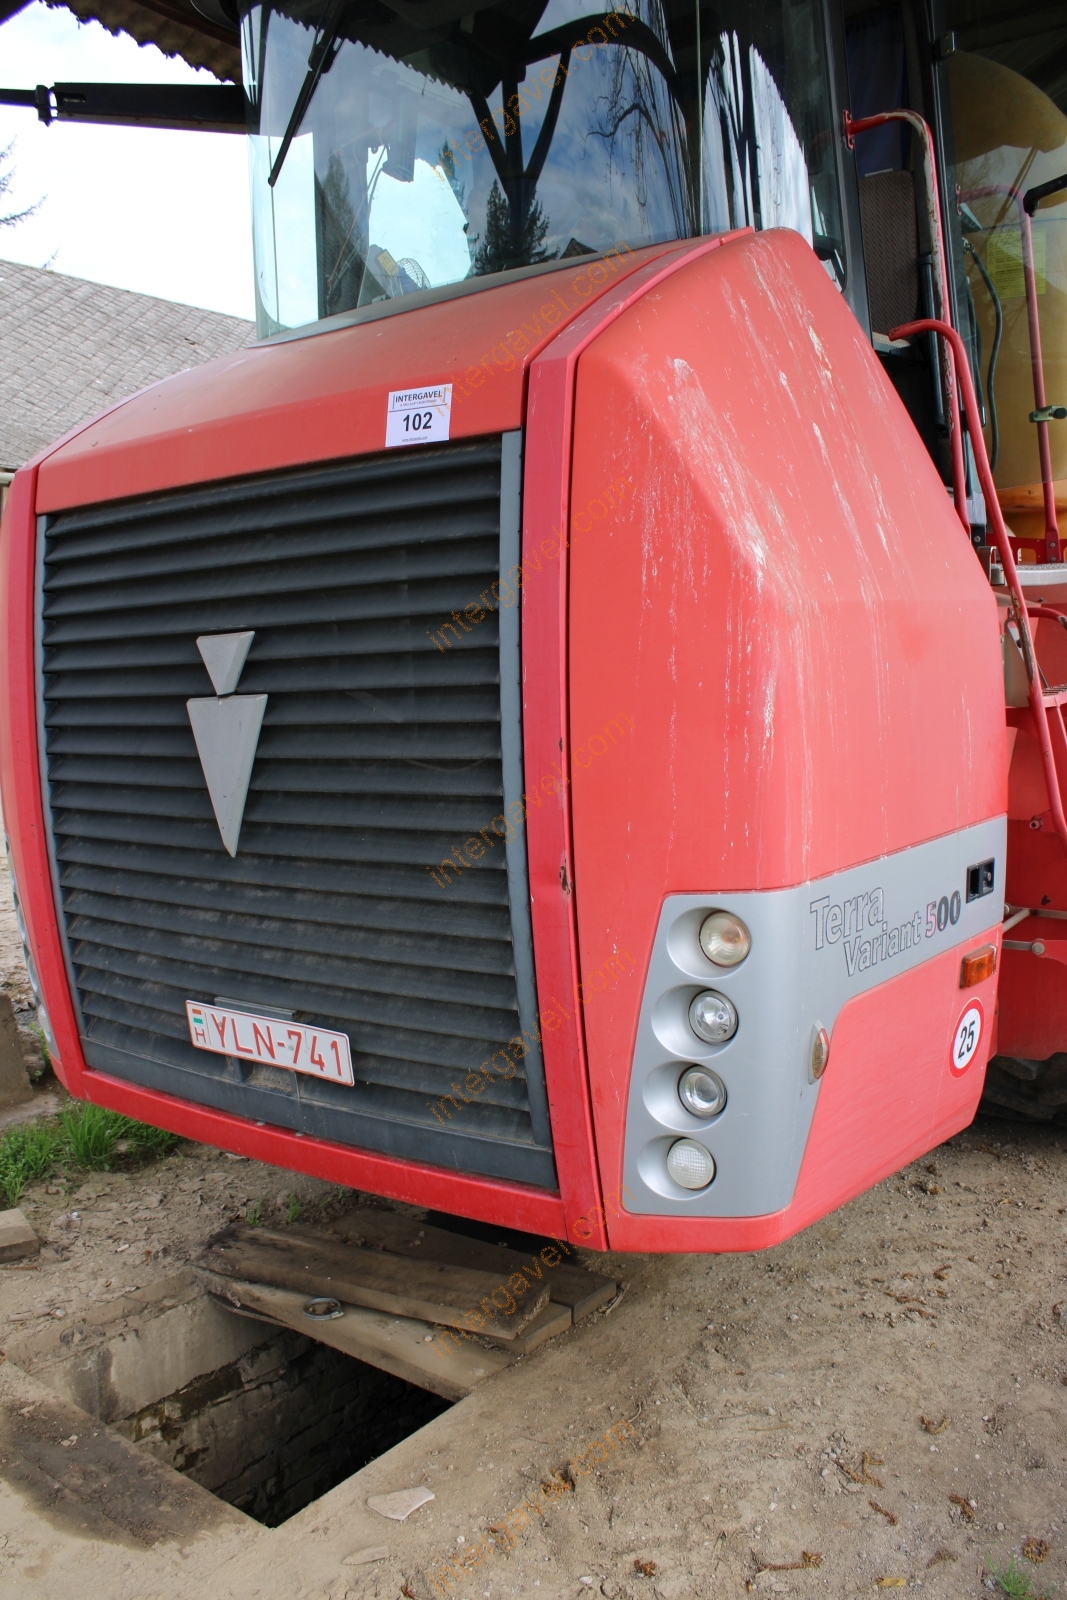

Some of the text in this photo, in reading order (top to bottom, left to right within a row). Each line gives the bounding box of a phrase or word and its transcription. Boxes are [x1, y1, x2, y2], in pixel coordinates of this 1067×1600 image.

[395, 390, 442, 403] INTERGAVEL
[402, 411, 433, 432] 102
[810, 886, 885, 951] Terra
[842, 889, 962, 977] Variant 500
[194, 1026, 207, 1044] H
[210, 1012, 343, 1077] YLN-741
[957, 1019, 976, 1059] 25
